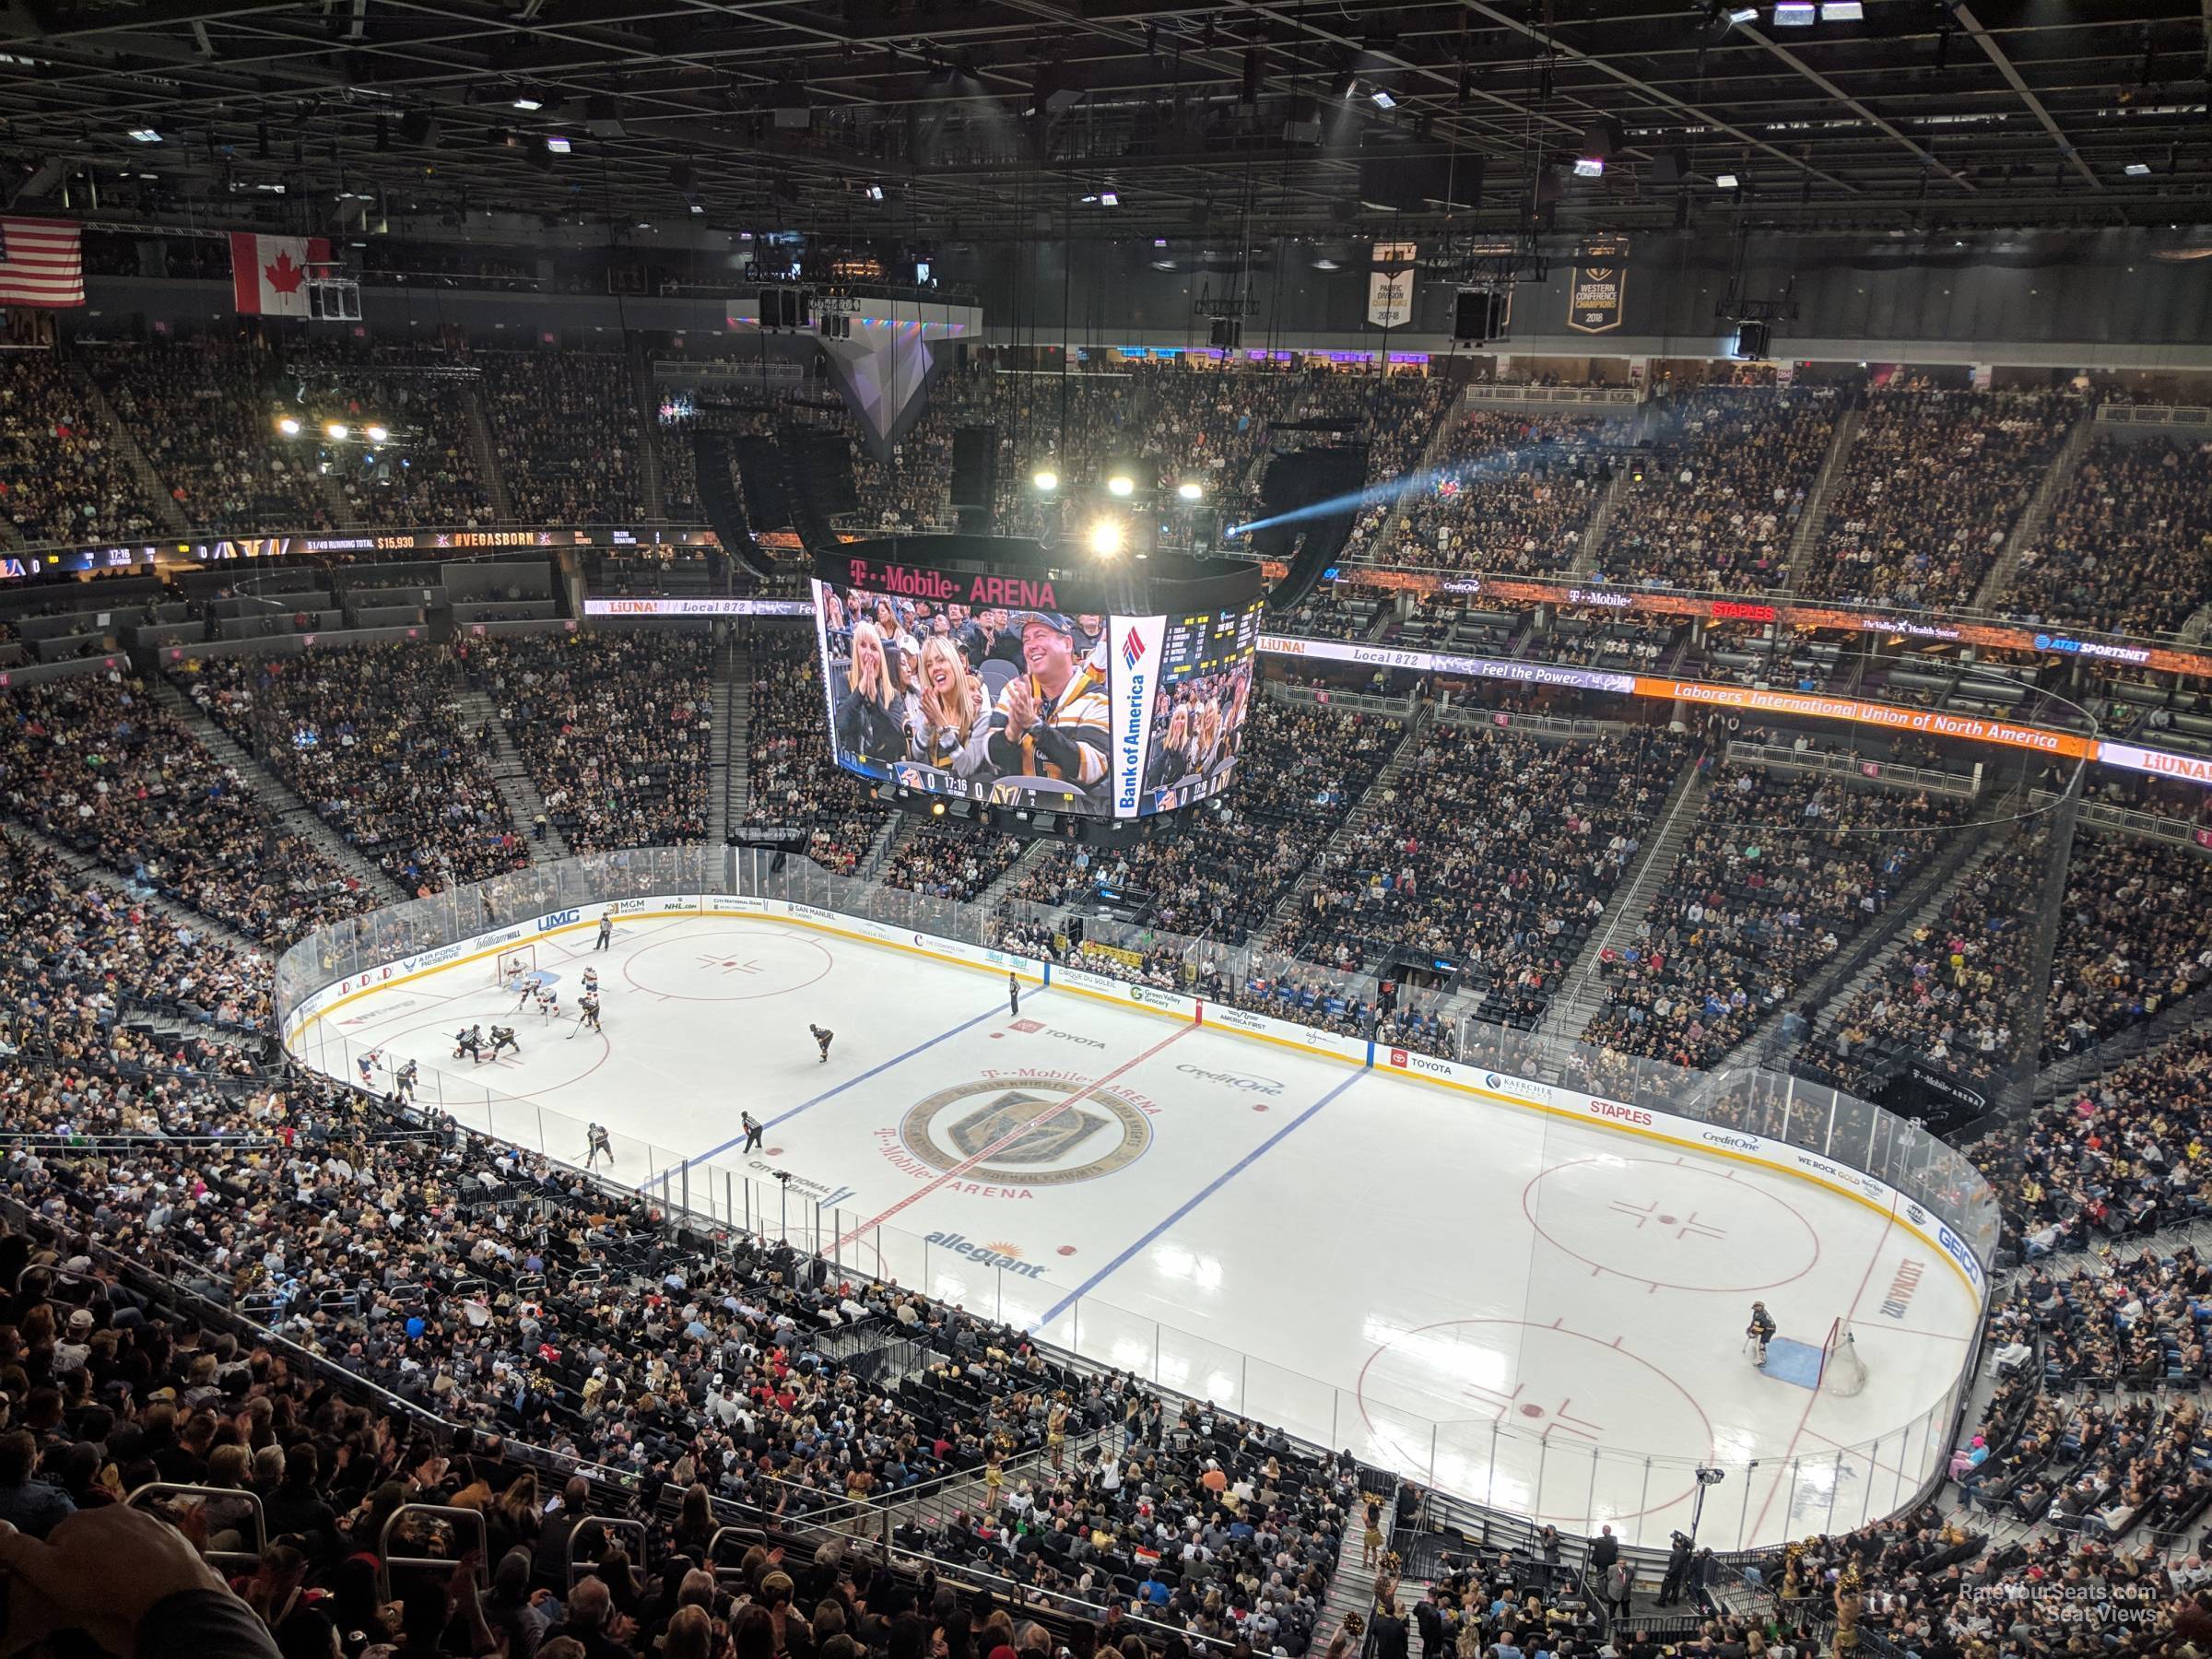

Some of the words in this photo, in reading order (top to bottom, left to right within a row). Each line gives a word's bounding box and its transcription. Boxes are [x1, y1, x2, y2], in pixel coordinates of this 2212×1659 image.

[1576, 292, 1618, 300] CONFERENCE
[1581, 284, 1616, 292] WESTERN
[1575, 300, 1617, 309] CHAMPIONS
[1585, 313, 1604, 322] 2018
[328, 540, 356, 549] RUNNING
[356, 539, 374, 548] TOTAL
[377, 536, 415, 549] $15,930
[454, 532, 535, 546] #VEGASBORN
[970, 575, 1058, 610] ARENA
[608, 601, 659, 613] LiUNA!
[681, 601, 720, 612] Local
[722, 602, 746, 612] 872
[1712, 602, 1775, 621] STAPLES
[1863, 619, 1875, 629] The
[1875, 621, 1898, 633] Valley
[1908, 624, 1935, 636] Health
[1935, 628, 1959, 639] System
[1259, 638, 1306, 654] LiUNA!
[1353, 649, 1391, 664] Local
[1394, 653, 1419, 666] 872
[2079, 643, 2149, 662] SPORTSNET
[1482, 663, 1510, 677] Feel
[1511, 666, 1532, 679] the
[1535, 669, 1579, 685] Power
[1124, 674, 1145, 746] America
[1749, 691, 1858, 718] International
[1862, 705, 1909, 724] Union
[1912, 714, 1932, 730] of
[1933, 715, 1983, 736] North
[1986, 724, 2058, 748] America
[1123, 747, 1139, 765] of
[927, 773, 935, 790] 0
[944, 776, 968, 792] 17:16
[974, 782, 983, 799] 0
[1119, 767, 1137, 808] Bank
[1181, 786, 1188, 805] 0
[620, 900, 645, 909] MGM
[794, 904, 809, 913] SAN
[809, 908, 836, 921] MANUEL
[537, 909, 581, 932] UMC
[418, 955, 429, 963] AIR
[429, 945, 463, 959] FORCE
[420, 951, 461, 967] RESERVE
[1058, 969, 1084, 980] CIRQUE
[1082, 974, 1094, 982] DU
[1093, 977, 1118, 989] SOLEIL
[1144, 989, 1164, 1000] Green
[1163, 994, 1181, 1005] Valley
[1144, 996, 1170, 1008] Grocery
[1219, 1015, 1246, 1026] AMERICA
[1246, 1019, 1266, 1030] FIRST
[1044, 1029, 1106, 1050] TOYOTA
[1411, 1058, 1453, 1076] TOYOTA
[1503, 1077, 1553, 1096] KAERCHER
[1105, 1082, 1161, 1117] ARENA
[1952, 1088, 1979, 1107] ARENA
[1591, 1100, 1653, 1126] STAPLES
[748, 1160, 776, 1172] CITY
[1798, 1156, 1812, 1166] WE
[1812, 1161, 1837, 1176] ROCK
[1837, 1171, 1860, 1185] GOLD
[945, 1182, 1034, 1200] ARENA
[924, 1230, 1046, 1279] allegiant
[1938, 1227, 1979, 1285] GEICO
